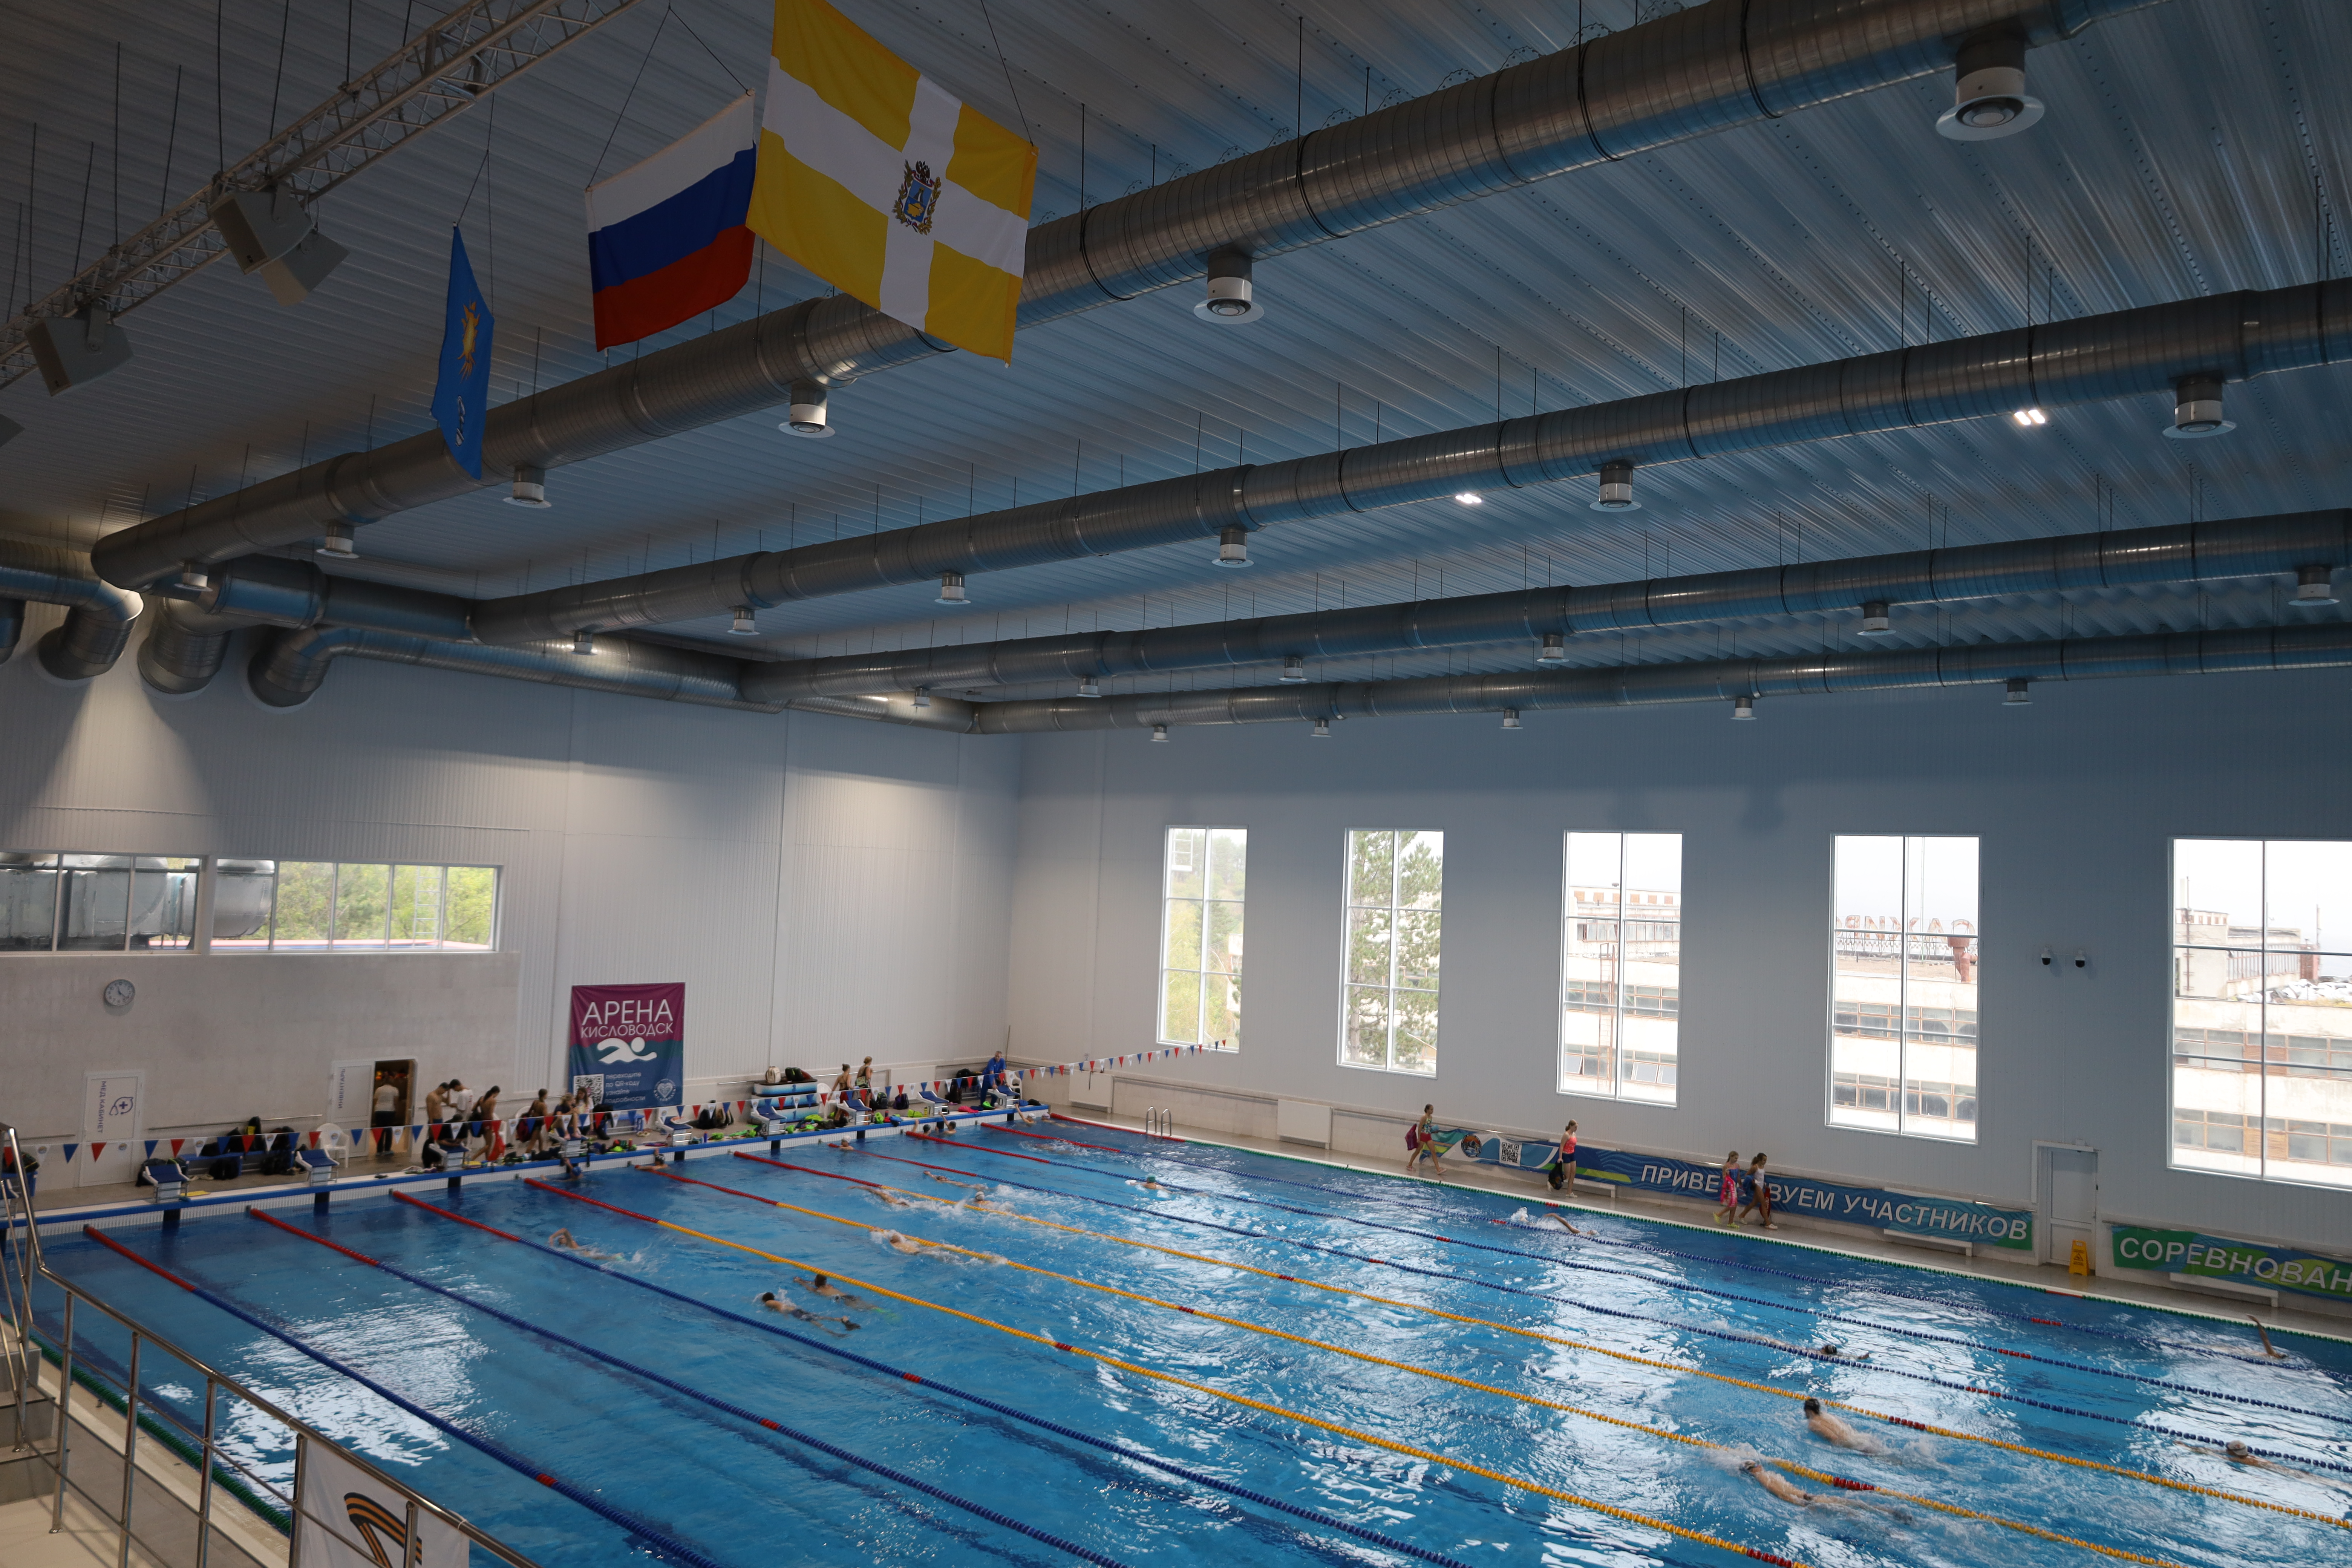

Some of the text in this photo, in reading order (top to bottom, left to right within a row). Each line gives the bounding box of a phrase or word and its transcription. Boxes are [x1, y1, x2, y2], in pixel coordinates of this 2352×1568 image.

[581, 1022, 674, 1038] КИСЛОВОДСК
[582, 999, 674, 1025] АРЕНА
[1641, 1164, 1835, 1211] ПРИВЕВУЕМ
[1843, 1193, 2027, 1240] УЧАСТНИКОВ
[2119, 1237, 2352, 1292] СОРЕВНОВАН
